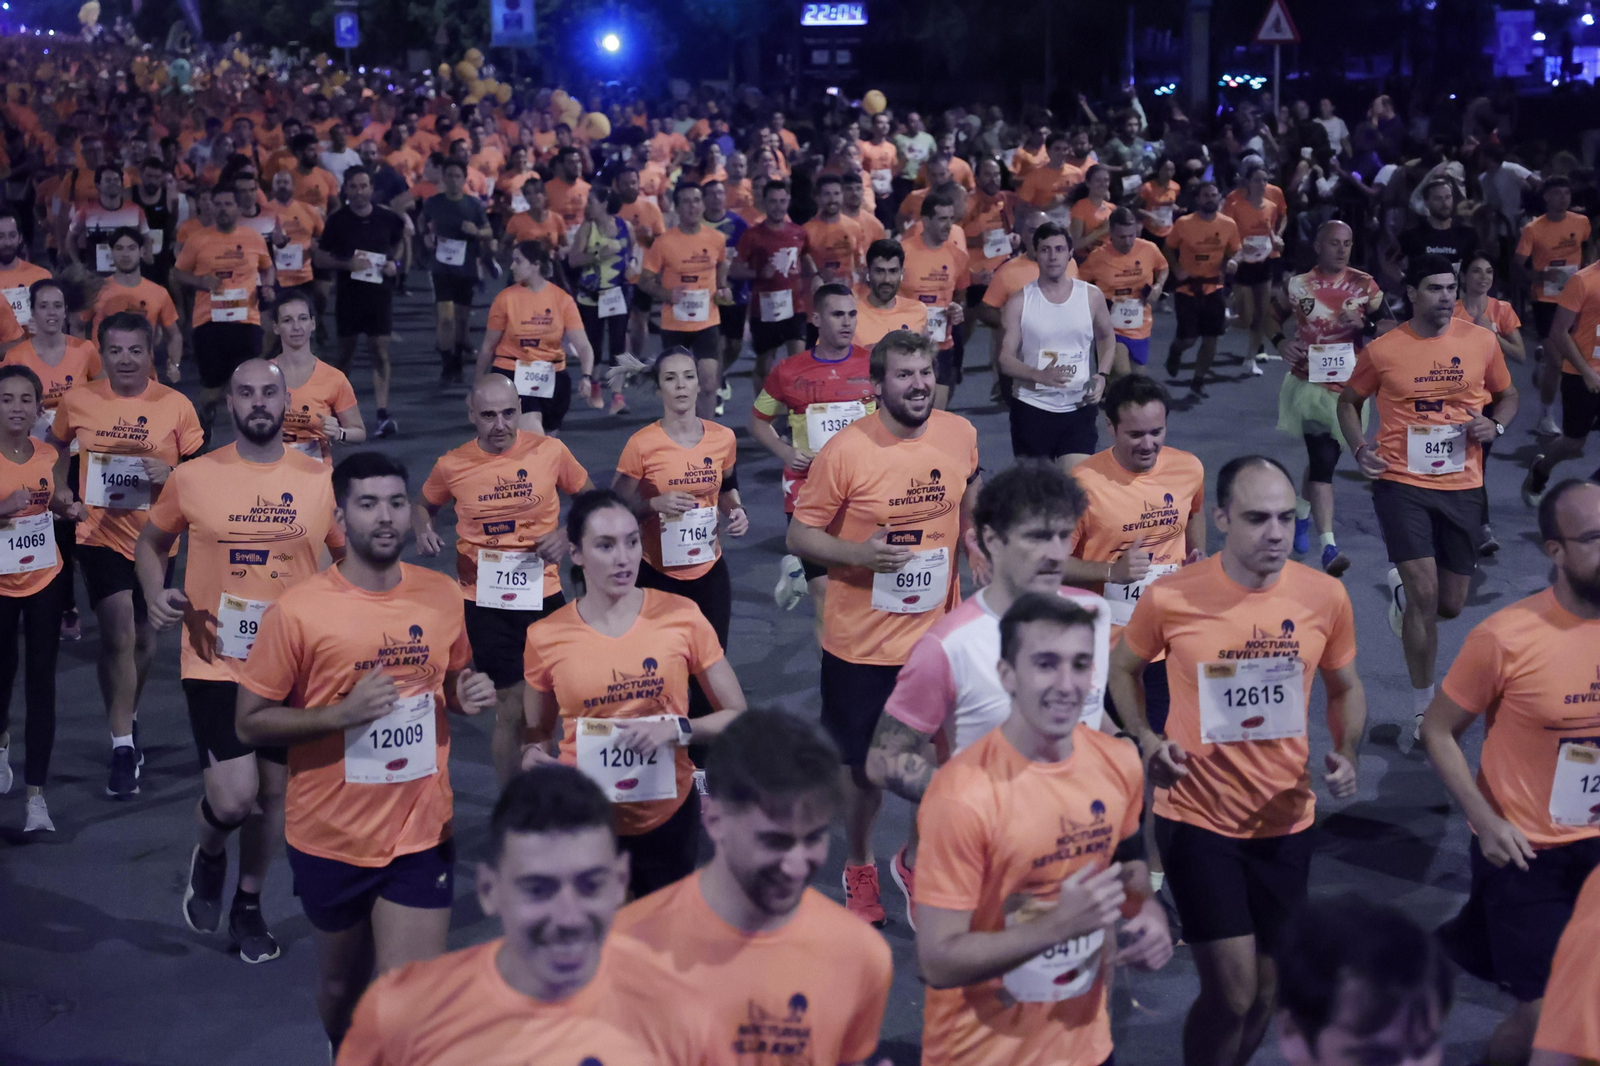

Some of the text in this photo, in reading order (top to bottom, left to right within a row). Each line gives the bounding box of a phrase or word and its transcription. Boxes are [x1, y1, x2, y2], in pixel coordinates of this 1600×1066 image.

[804, 4, 862, 22] 22:04
[1322, 357, 1345, 368] 3715
[112, 425, 149, 434] NOCTURNA
[820, 419, 857, 432] 1336
[95, 430, 147, 441] SEVILLA KH7
[1425, 442, 1453, 454] 8473
[685, 469, 717, 477] NOCTURNA
[101, 473, 139, 488] 14068
[669, 478, 701, 486] SEVILLA
[494, 483, 533, 492] NOCTURNA
[907, 485, 946, 496] NOCTURNA
[478, 488, 533, 502] SEVILLA KH7
[889, 493, 945, 506] SEVILLA KH7
[250, 507, 297, 516] NOCTURNA
[1140, 509, 1179, 520] NOCTURNA
[228, 514, 296, 525] SEVILLA KH7
[1122, 516, 1178, 531] SEVILLA KH7
[680, 527, 708, 542] 7164
[8, 533, 46, 551] 14069
[496, 571, 528, 586] 7163
[896, 572, 931, 588] 6910
[1245, 640, 1300, 649] NOCTURNA
[378, 646, 430, 657] NOCTURNA
[1217, 649, 1271, 660] SEVILLA
[402, 654, 429, 667] KH7
[607, 678, 665, 693] NOCTURNA
[573, 686, 663, 708] SEVILLA KH7
[1223, 685, 1286, 708] 12615
[369, 723, 424, 750] 12009
